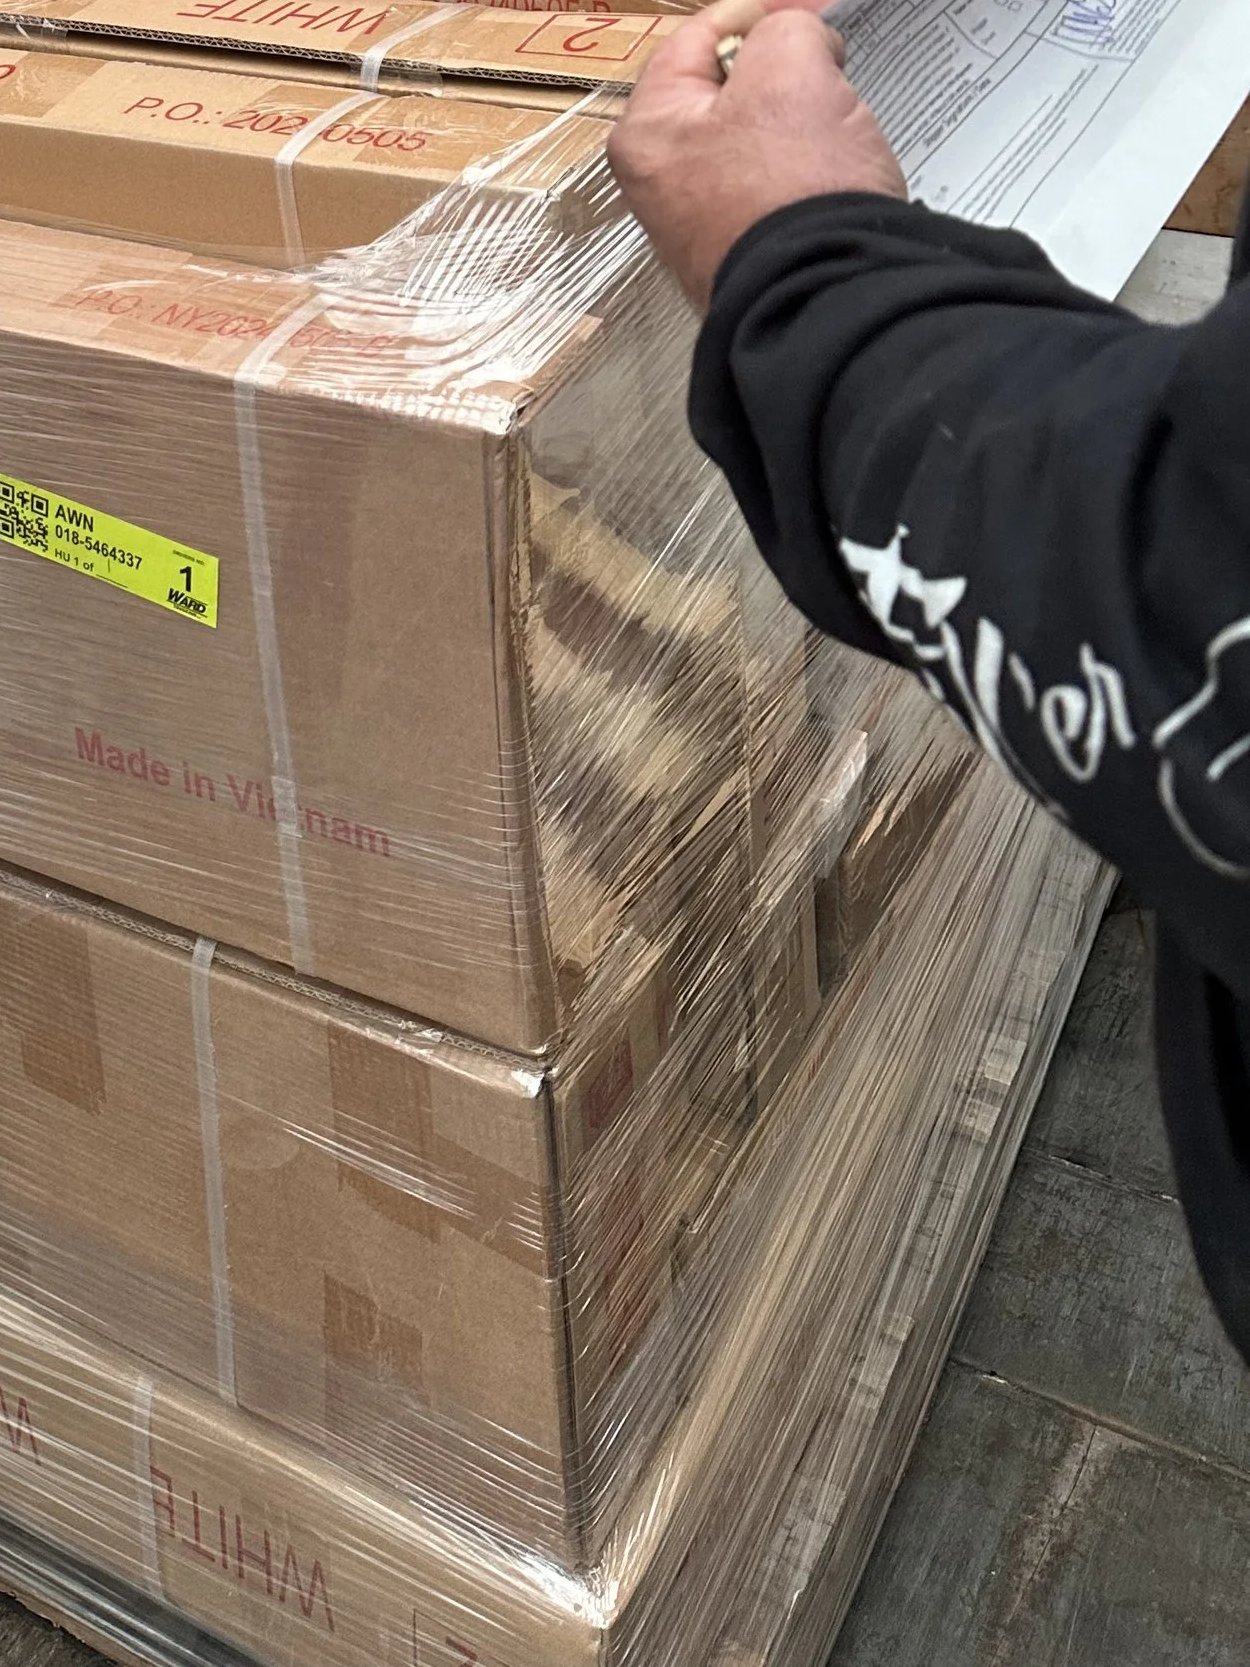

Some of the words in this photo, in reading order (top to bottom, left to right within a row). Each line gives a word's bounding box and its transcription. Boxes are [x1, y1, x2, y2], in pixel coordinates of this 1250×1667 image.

[563, 18, 622, 52] 2
[222, 109, 428, 152] 2020505
[55, 504, 94, 532] AWN
[54, 548, 71, 562] HU
[73, 556, 79, 566] 1
[82, 561, 94, 572] of
[55, 524, 143, 570] 018-5464337
[179, 565, 192, 593] 1
[168, 587, 207, 614] WARD
[74, 726, 171, 787] Made
[182, 761, 216, 803] in
[226, 772, 391, 858] Vienam
[151, 1466, 336, 1632] WHITE
